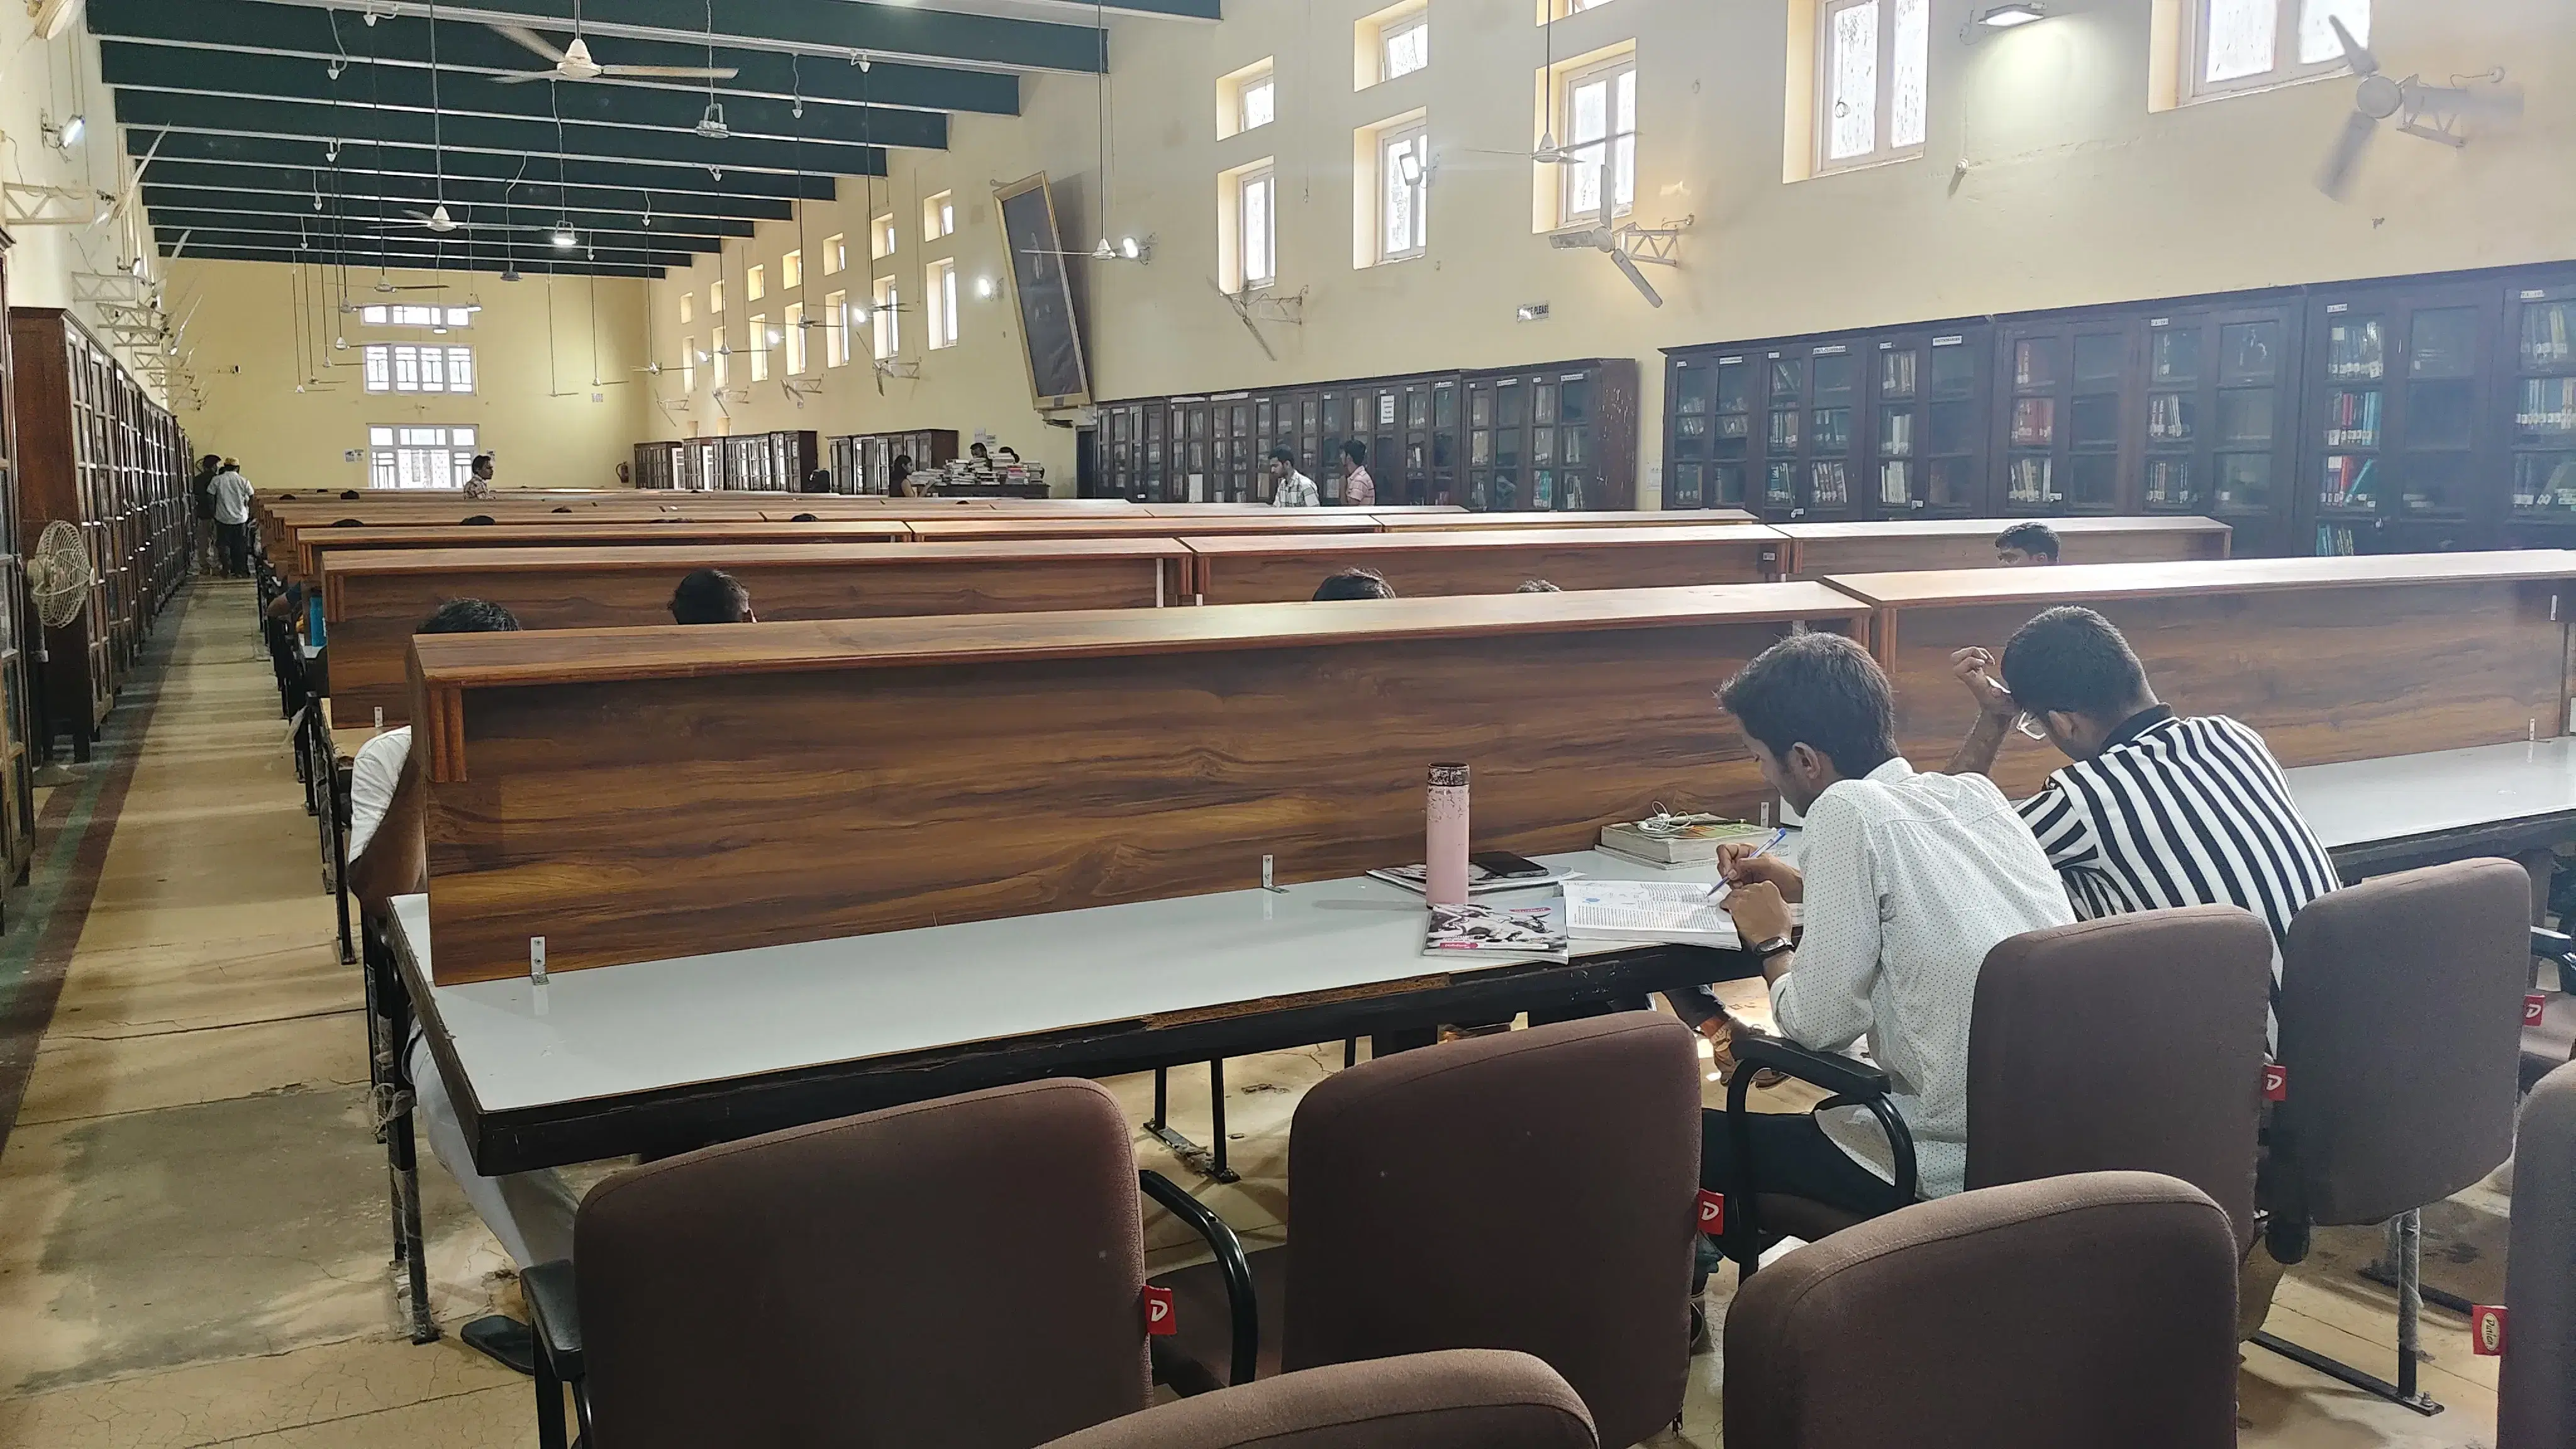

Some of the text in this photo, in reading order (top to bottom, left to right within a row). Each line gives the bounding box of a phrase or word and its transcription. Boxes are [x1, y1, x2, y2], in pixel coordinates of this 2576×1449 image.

[2526, 1004, 2541, 1018] D
[2266, 1074, 2282, 1091] D
[1701, 1201, 1719, 1221] D
[1150, 1299, 1169, 1322] D
